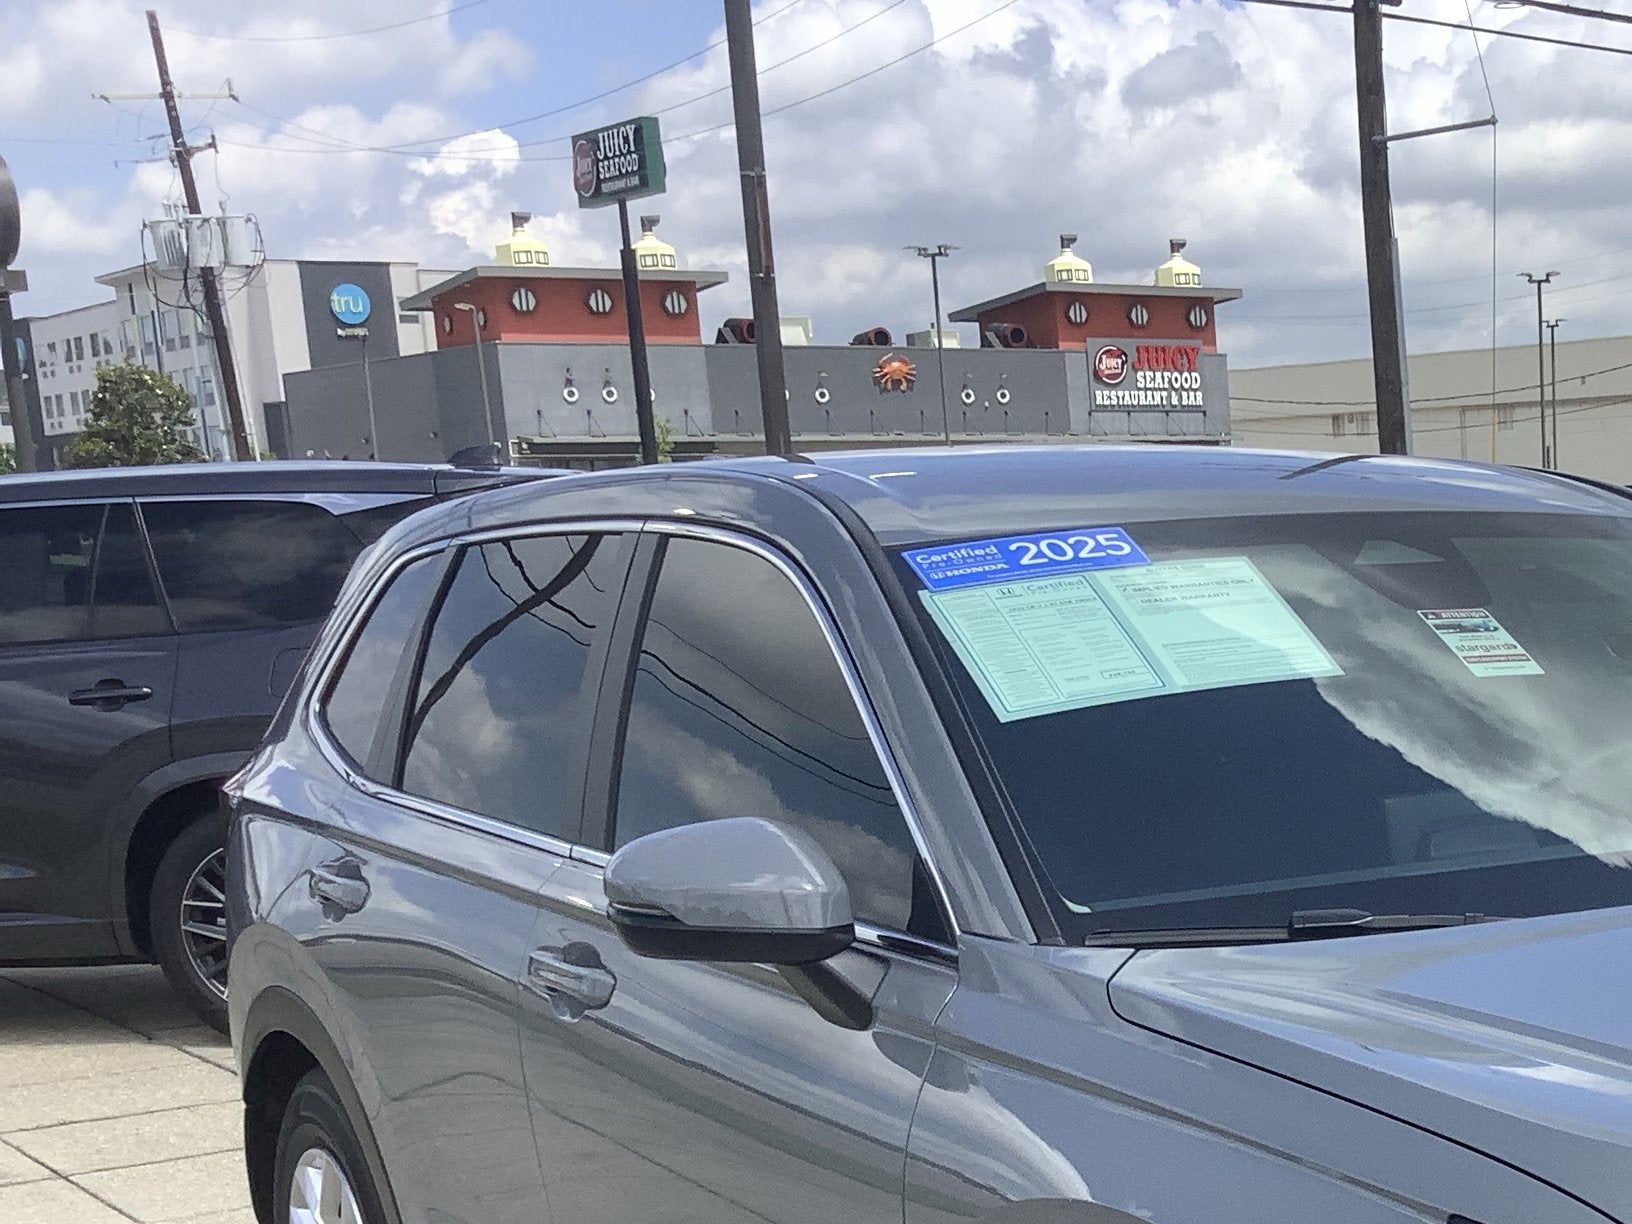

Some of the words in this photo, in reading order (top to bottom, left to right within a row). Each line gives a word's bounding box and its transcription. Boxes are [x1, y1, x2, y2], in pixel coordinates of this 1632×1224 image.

[597, 124, 635, 159] JUICY
[598, 153, 639, 179] SEAFOOD
[331, 292, 363, 312] tru
[1131, 345, 1200, 370] JUICY
[1136, 371, 1201, 389] SEAFOOD
[1095, 390, 1168, 405] RESTAURANT
[1171, 391, 1179, 405] &
[1181, 391, 1203, 406] BAR
[915, 544, 999, 564] Certified
[1008, 533, 1132, 566] 2025
[921, 553, 1003, 569] Pre-Owned
[945, 563, 1010, 577] HONDA
[1026, 579, 1084, 591] Certified
